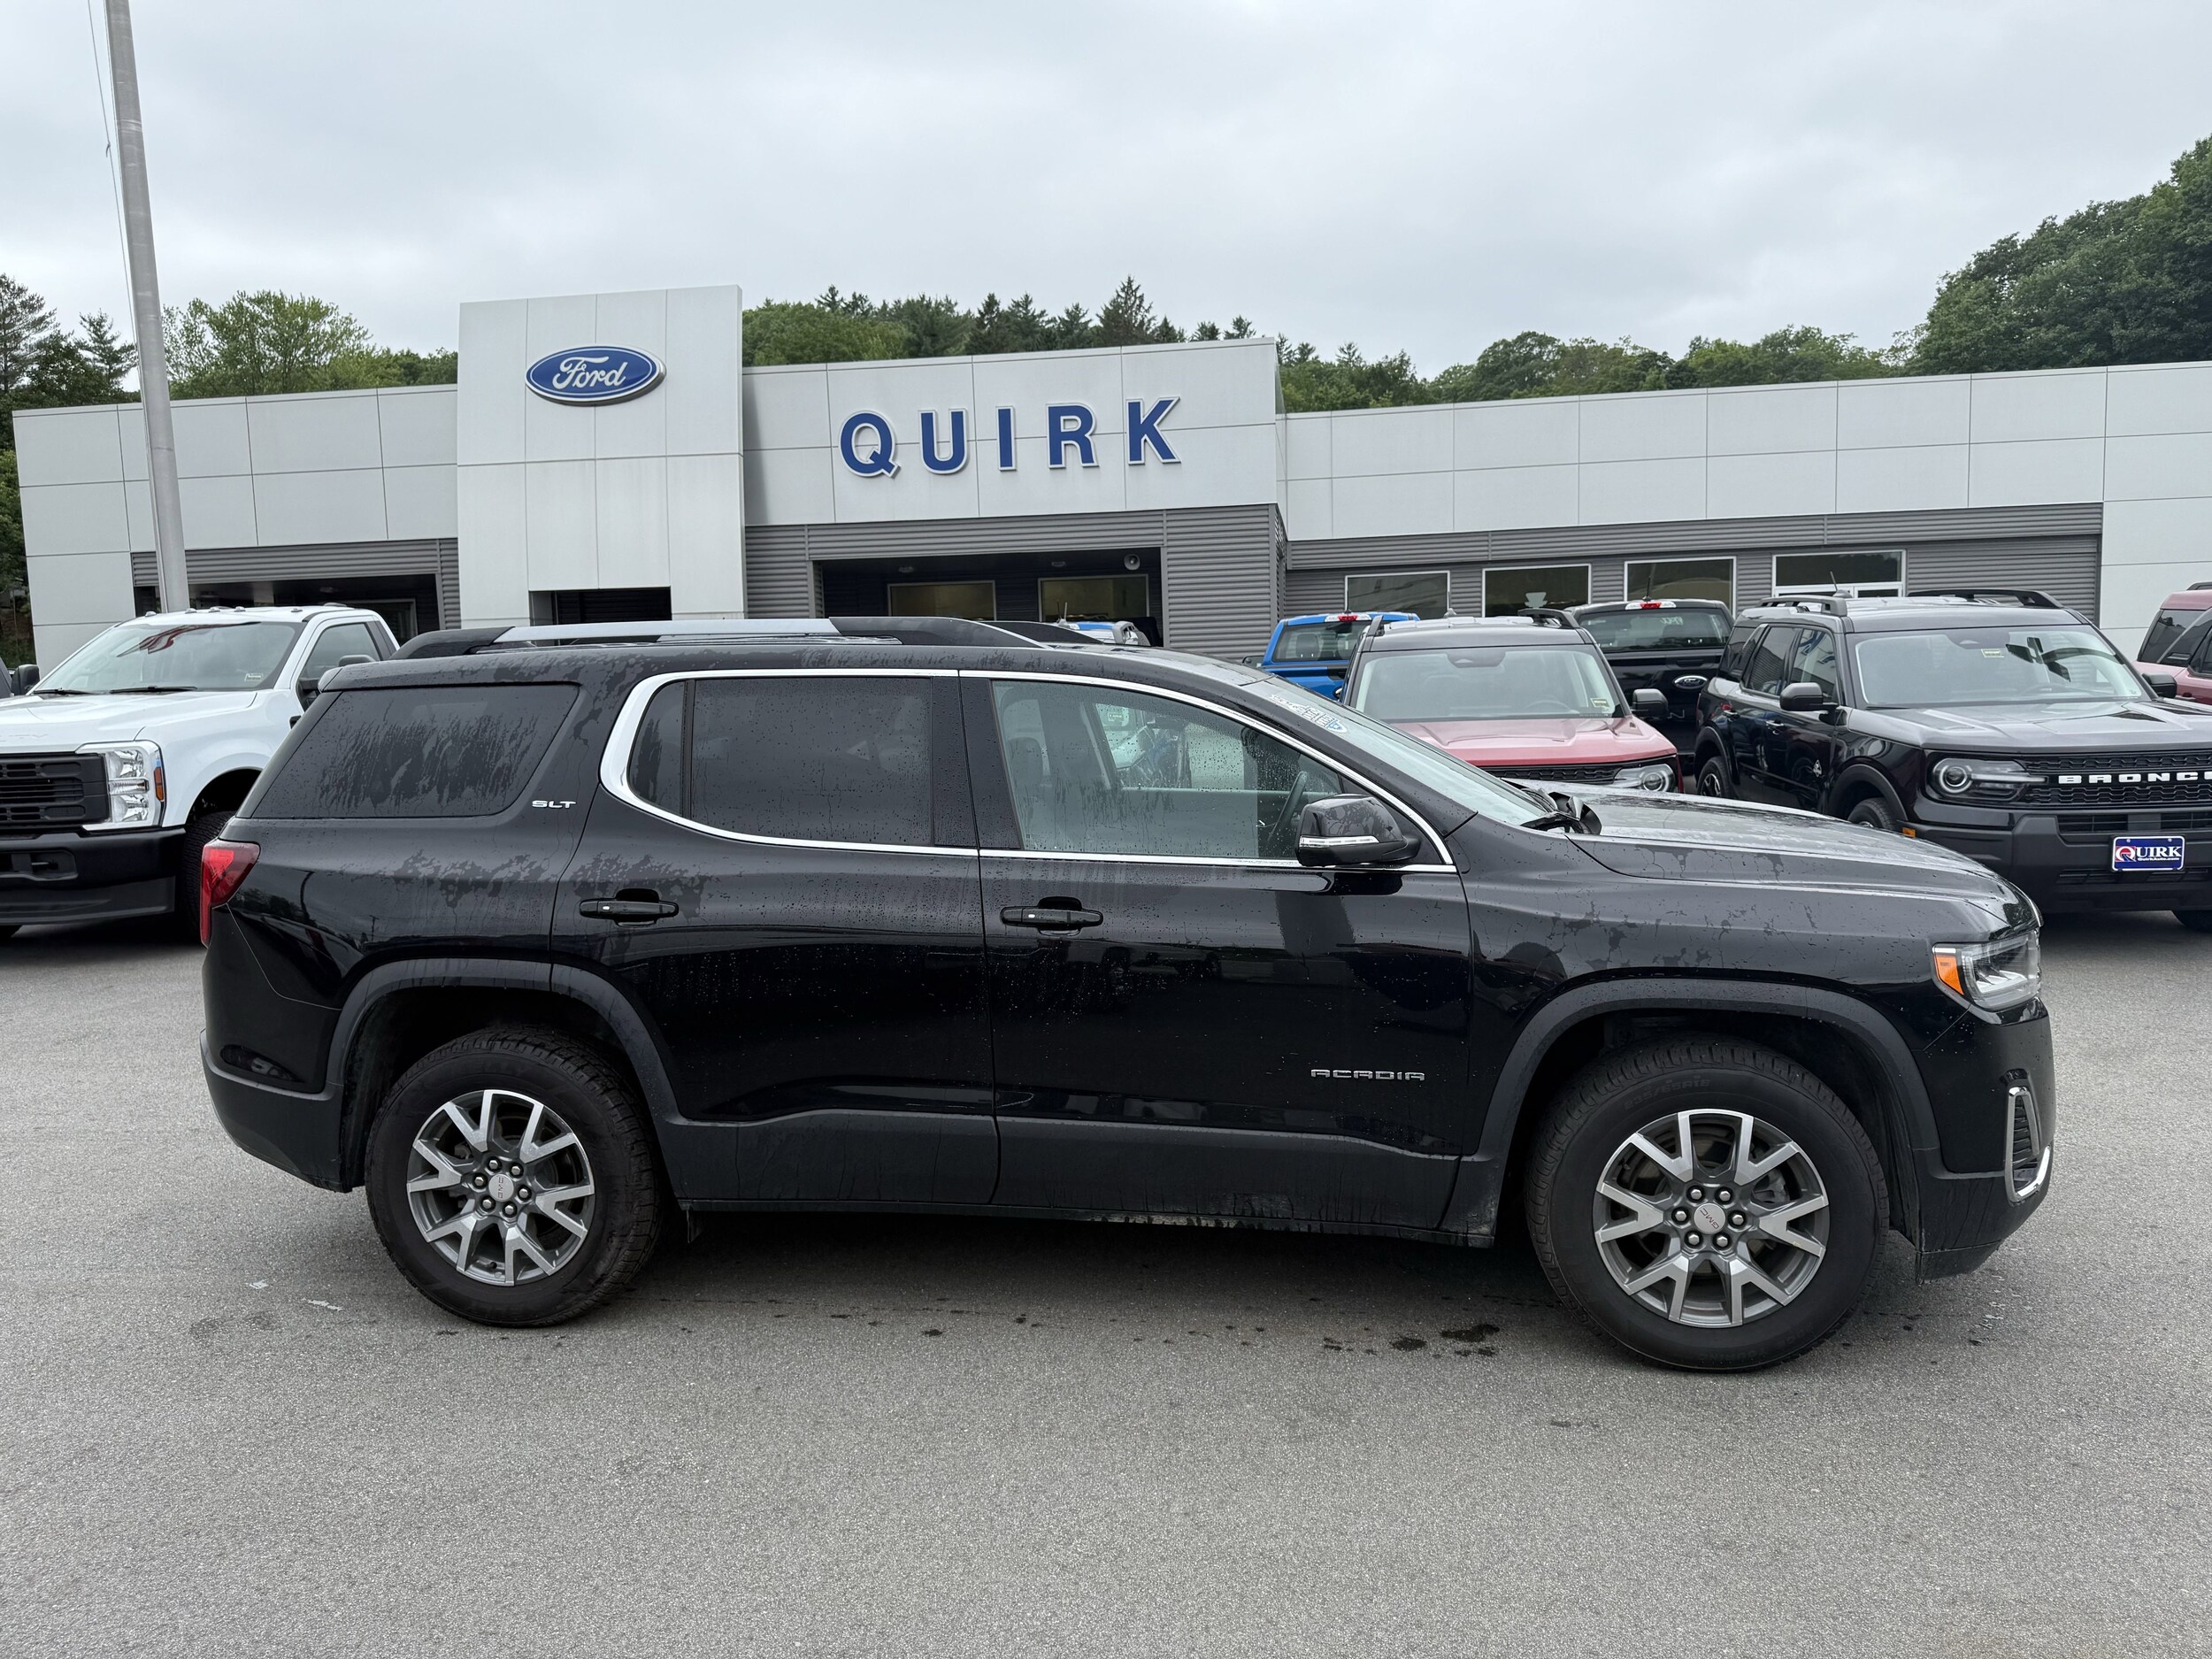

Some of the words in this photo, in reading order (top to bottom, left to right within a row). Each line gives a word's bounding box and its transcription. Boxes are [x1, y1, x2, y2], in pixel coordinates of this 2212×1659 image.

[552, 356, 629, 389] Ford
[839, 396, 1181, 479] QUIRK
[532, 800, 577, 809] SLT
[2116, 846, 2182, 862] QUIRK
[1310, 1069, 1425, 1081] ACADIA
[1700, 1207, 1720, 1230] GMC
